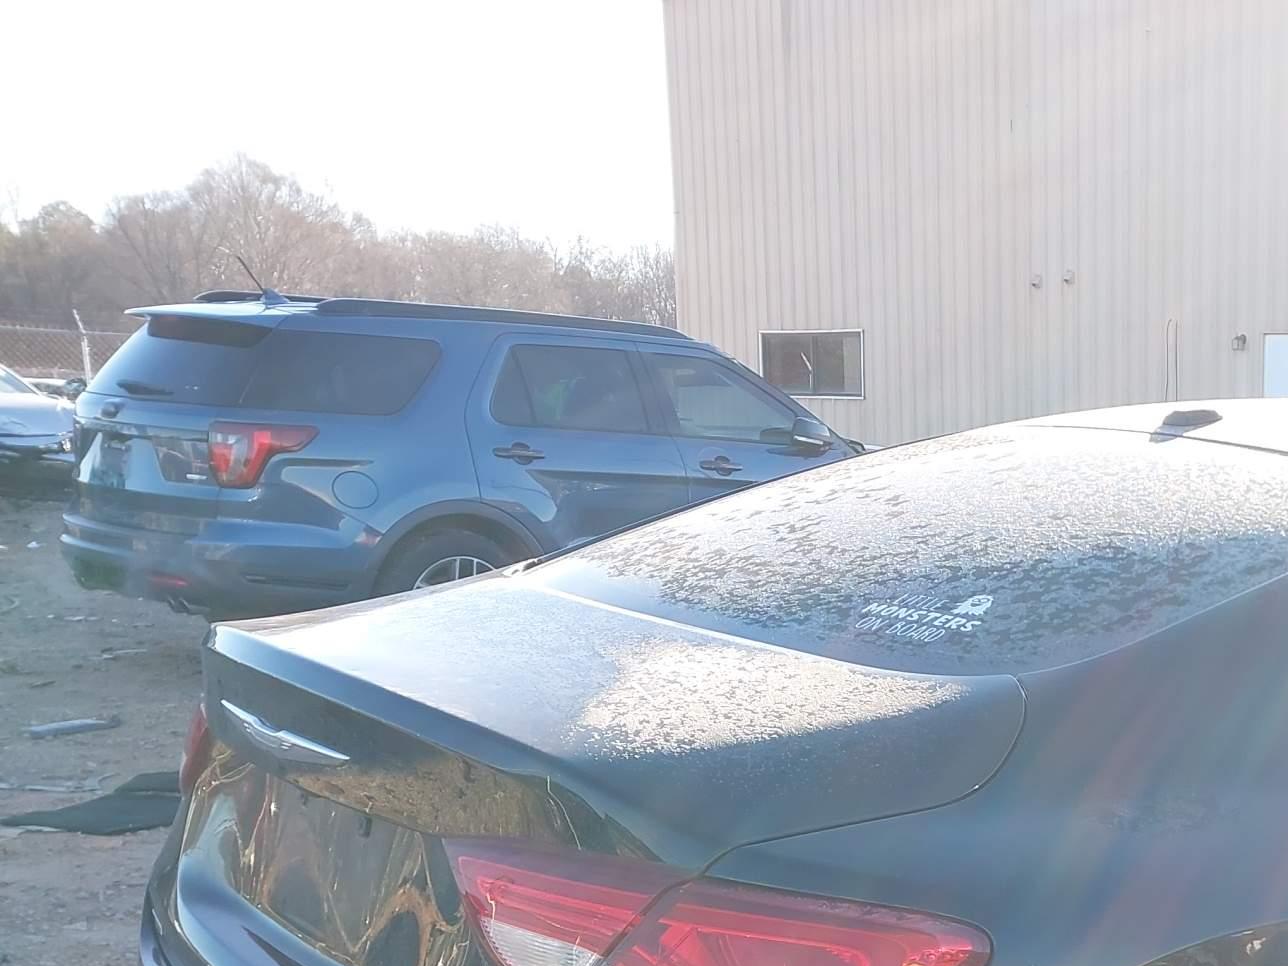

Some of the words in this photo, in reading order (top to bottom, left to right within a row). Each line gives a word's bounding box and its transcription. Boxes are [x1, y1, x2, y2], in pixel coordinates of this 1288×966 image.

[893, 593, 949, 611] LITTLE
[855, 616, 888, 631] ON
[886, 621, 945, 642] BOARD
[861, 602, 982, 632] MONSTERS
